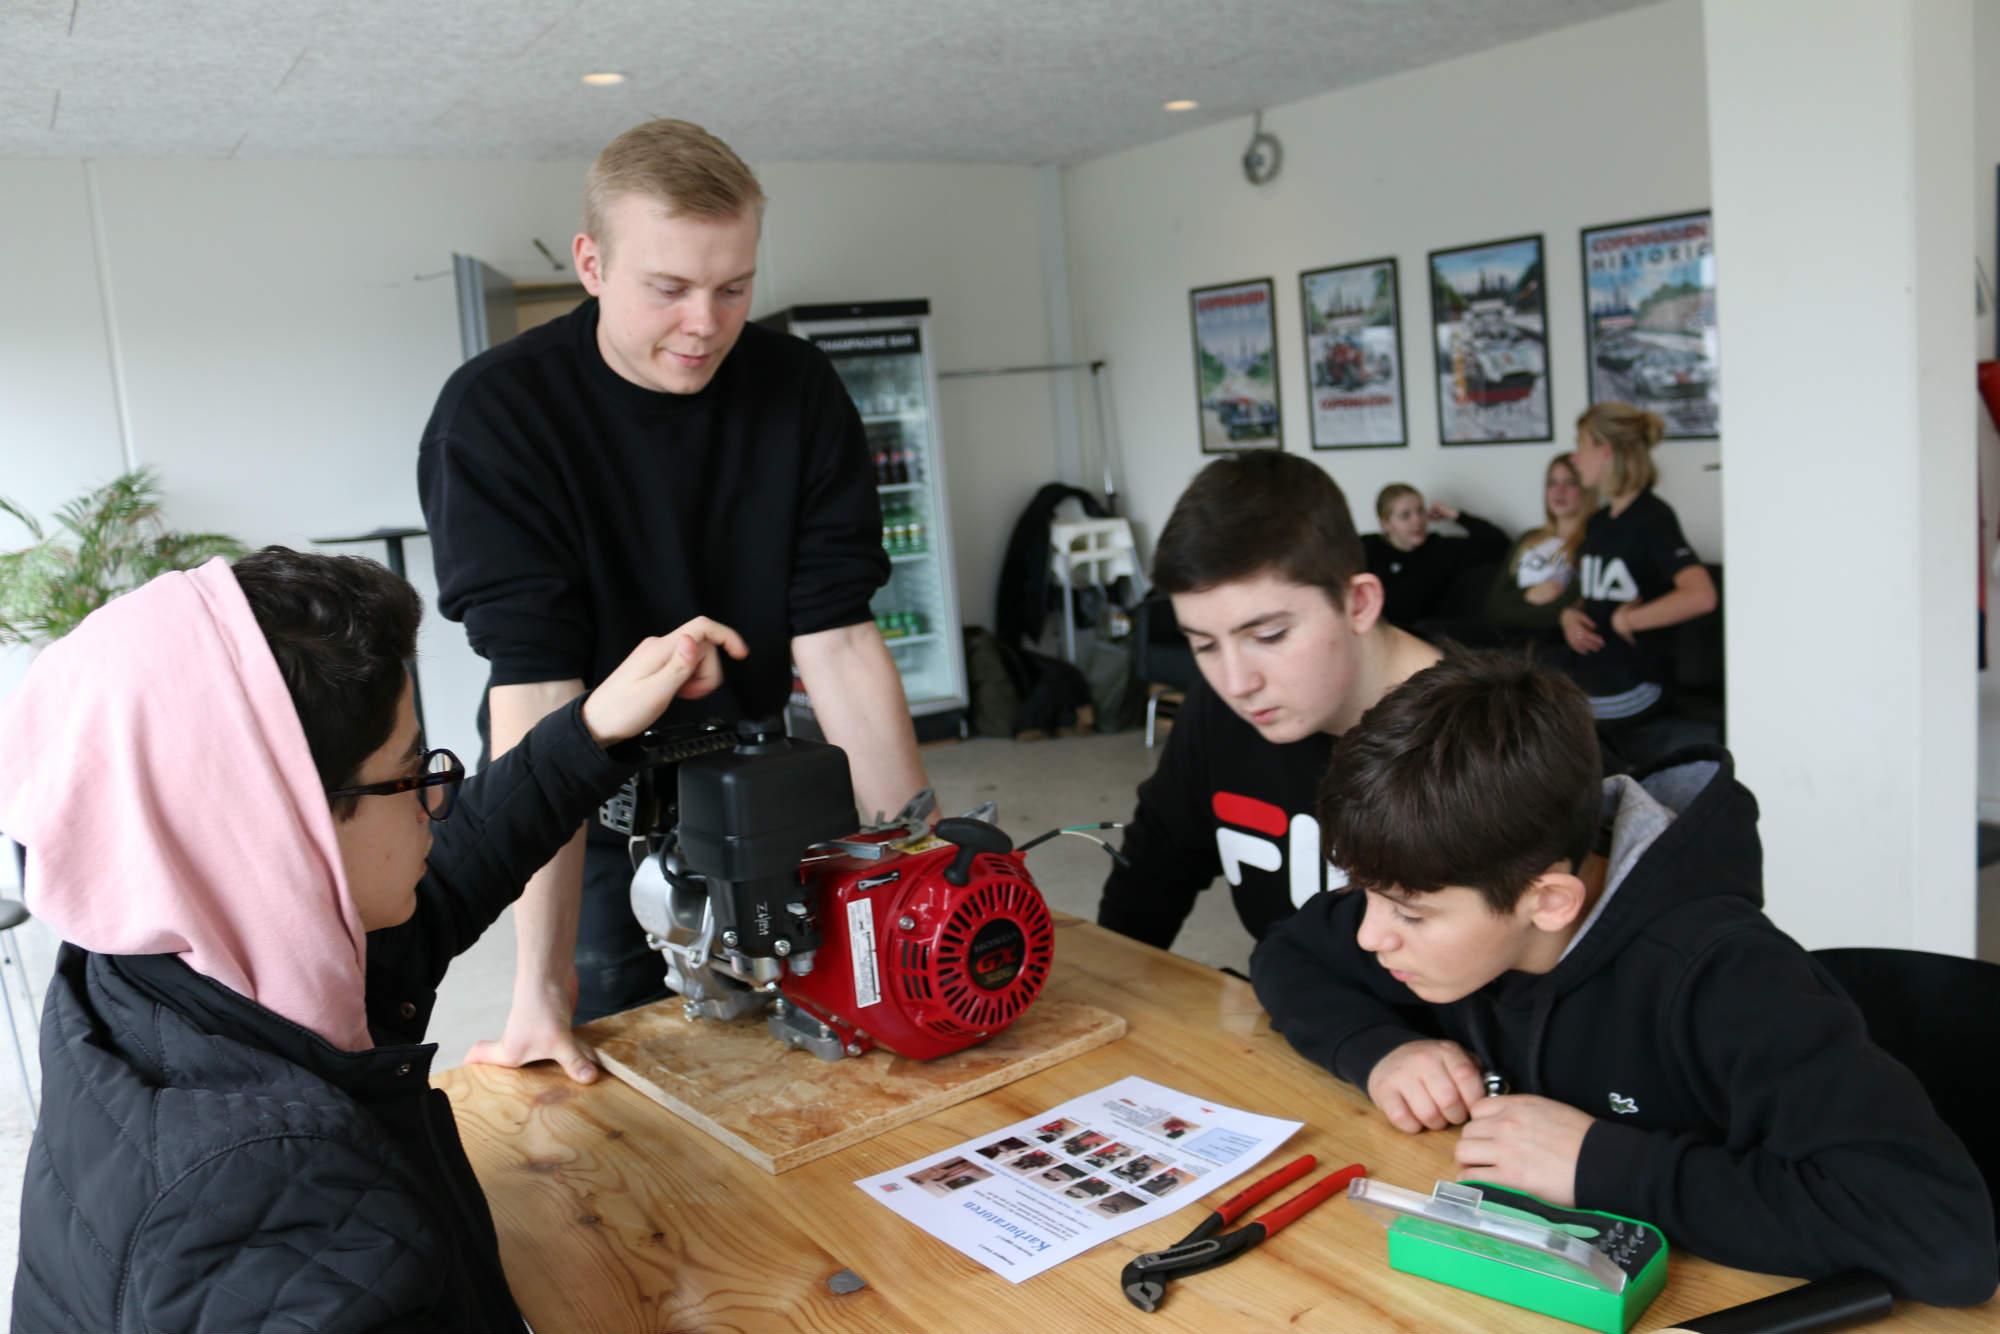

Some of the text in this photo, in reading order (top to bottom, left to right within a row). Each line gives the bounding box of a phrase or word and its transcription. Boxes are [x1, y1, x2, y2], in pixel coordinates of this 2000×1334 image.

[1592, 242, 1711, 270] HISTORIC
[887, 334, 914, 348] BAR
[1581, 553, 1639, 602] ILA
[962, 1201, 1052, 1252] Karburatoren
